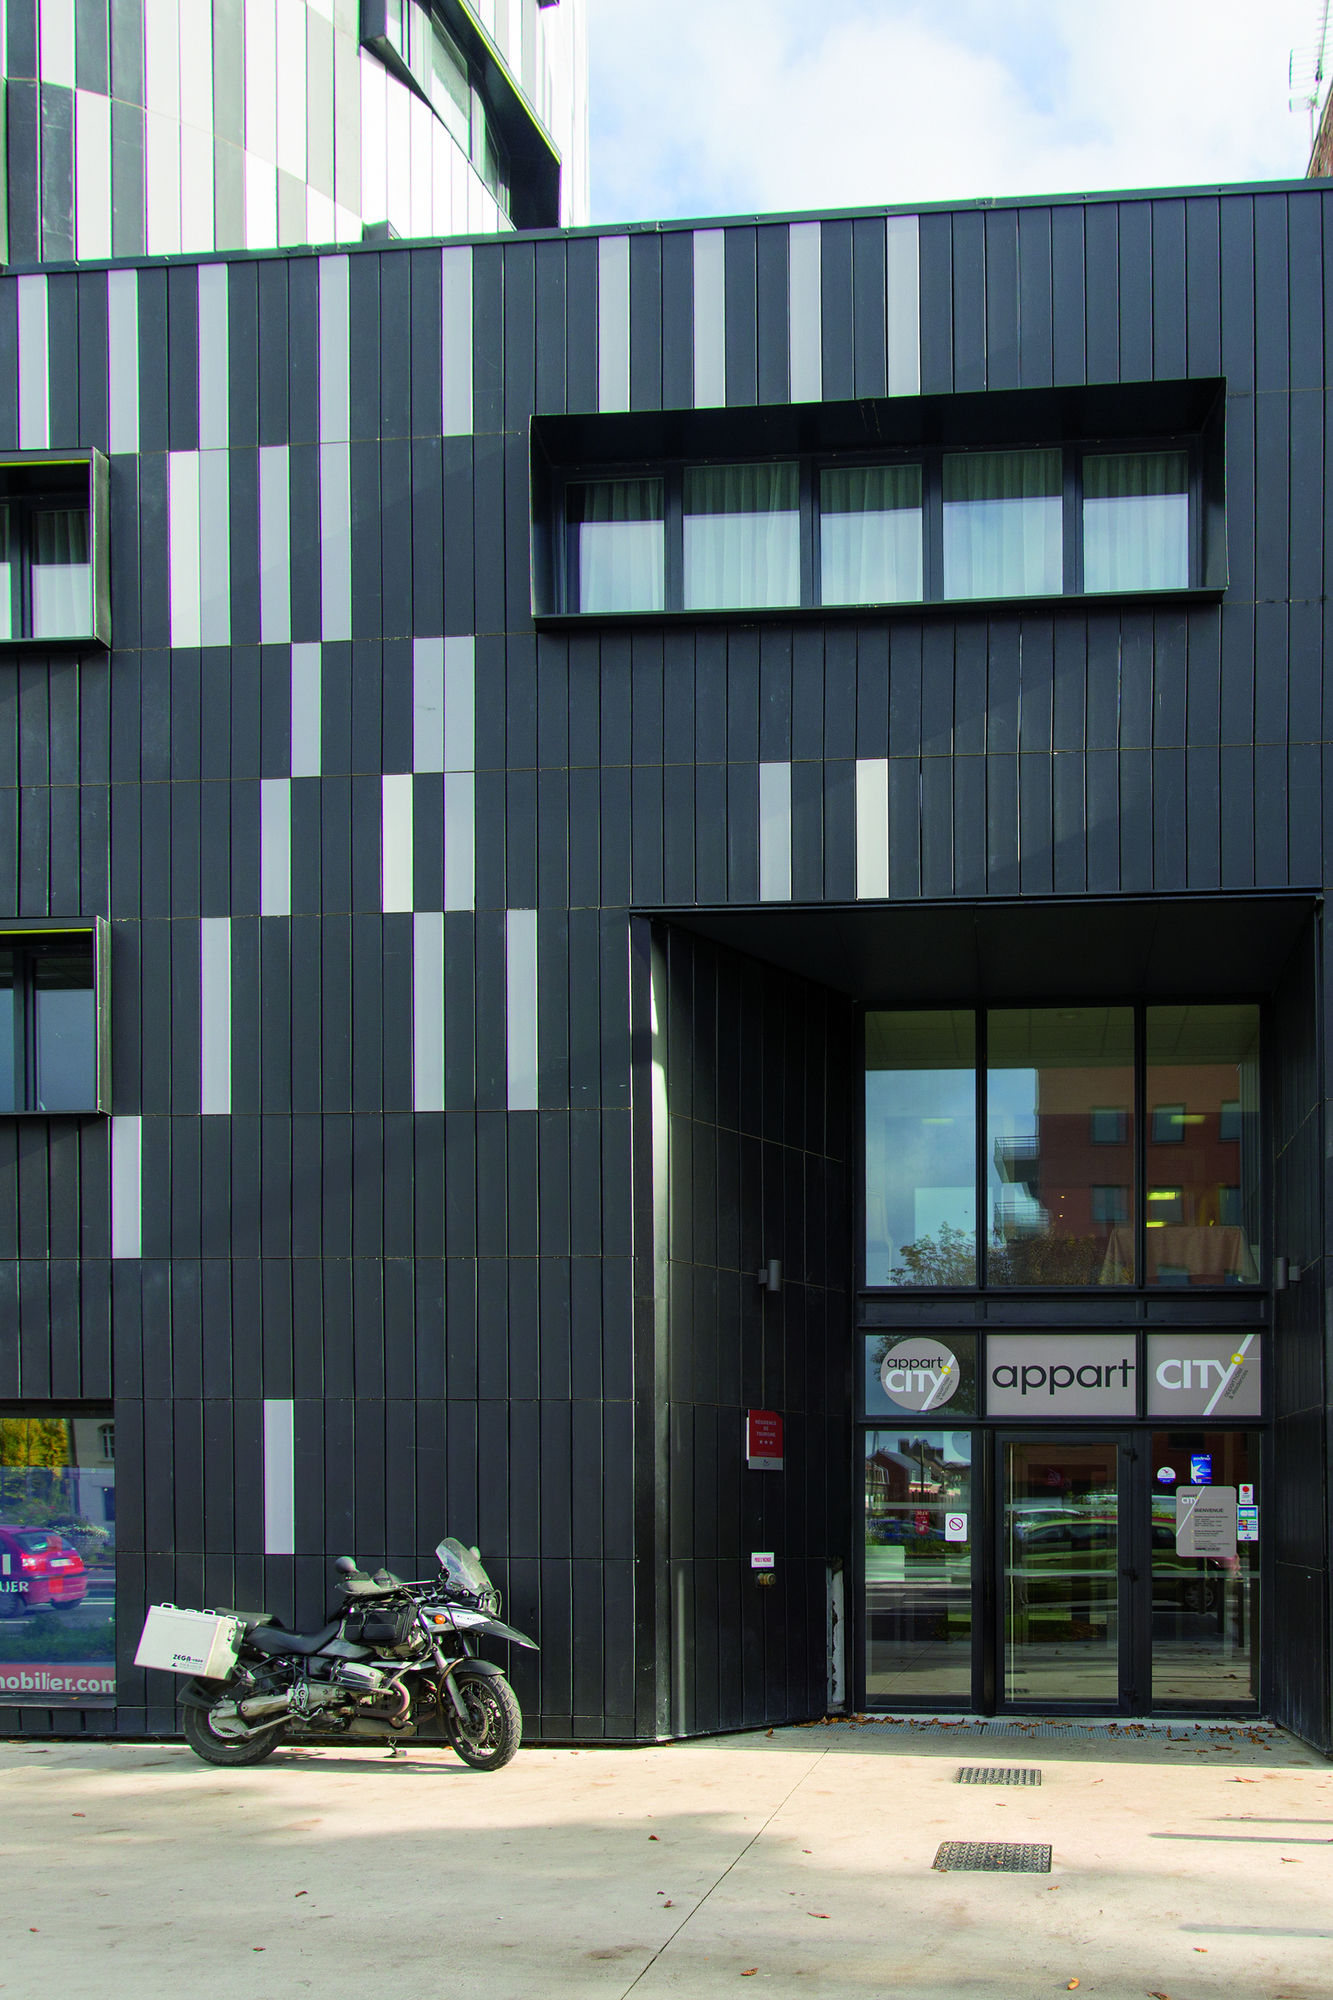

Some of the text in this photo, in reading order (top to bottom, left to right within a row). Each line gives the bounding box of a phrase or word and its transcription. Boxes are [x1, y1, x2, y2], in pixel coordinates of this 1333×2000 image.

[887, 1357, 943, 1370] appart
[886, 1369, 945, 1410] CITY
[992, 1359, 1135, 1395] appart
[1156, 1359, 1236, 1415] CITY
